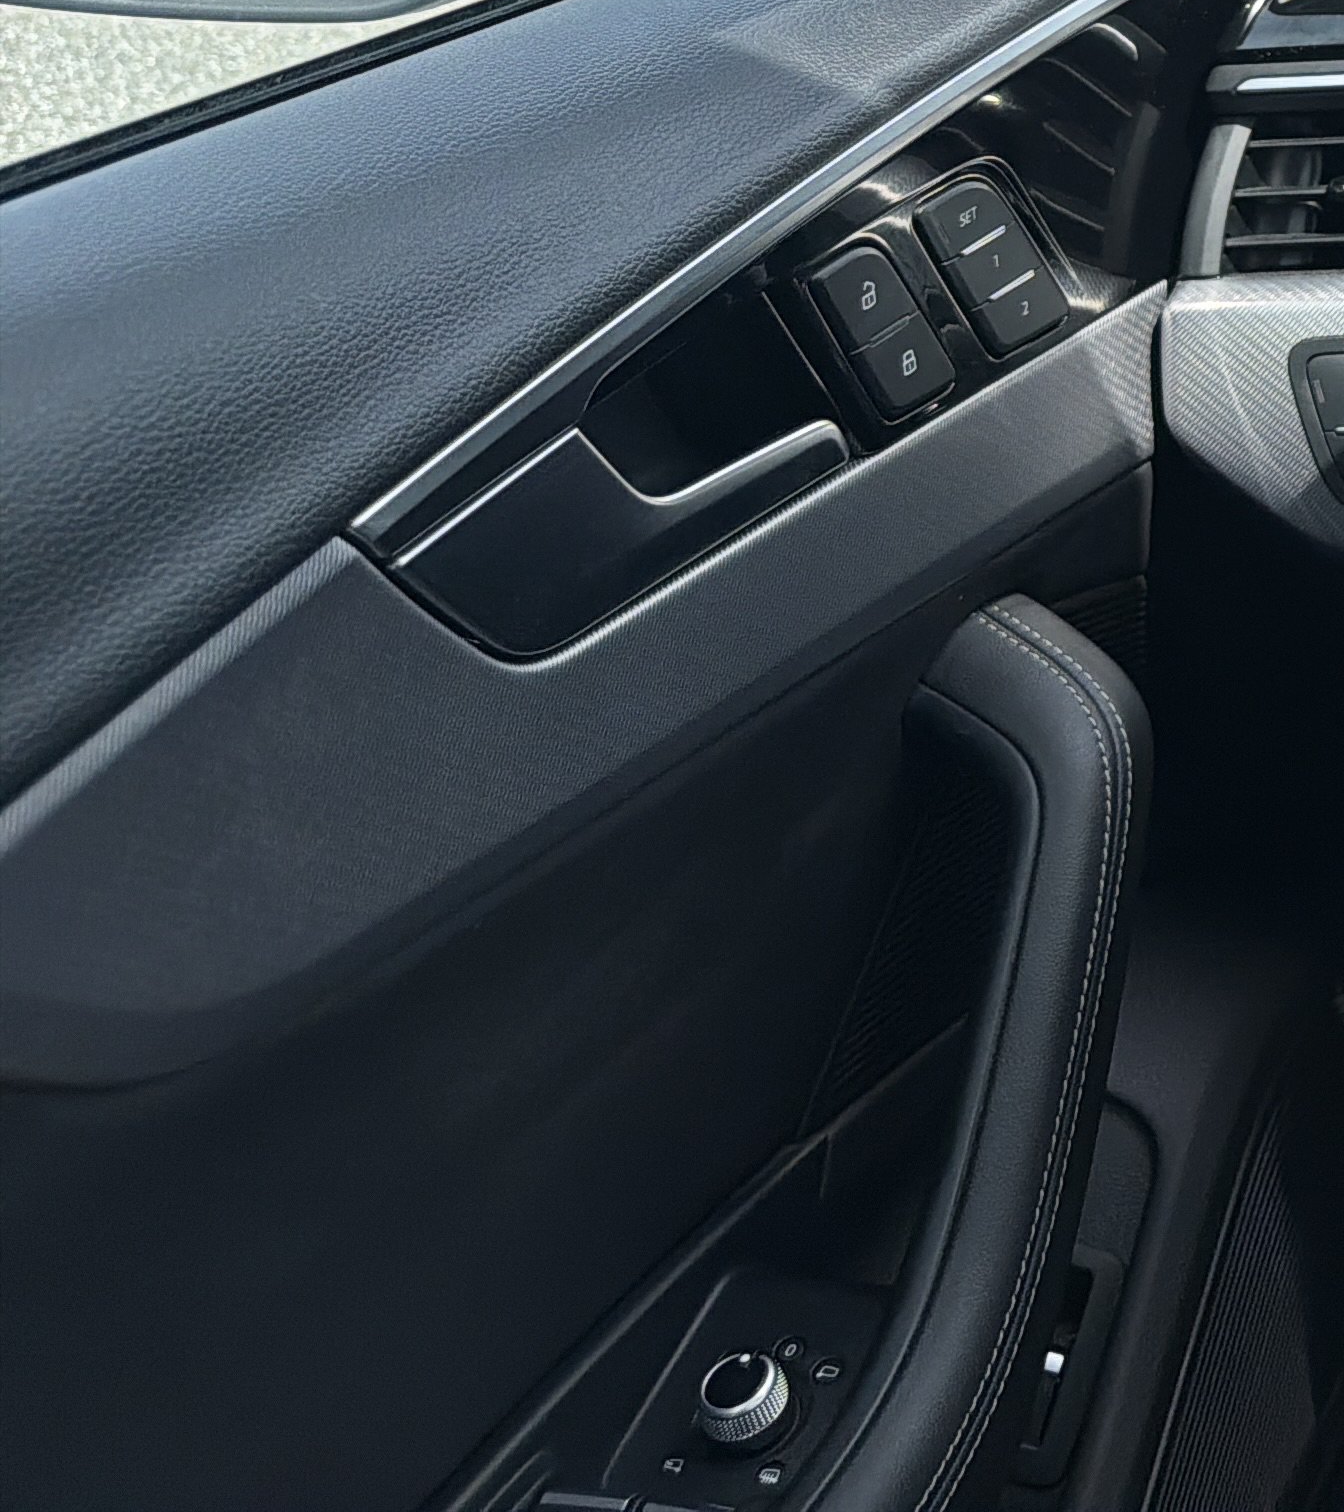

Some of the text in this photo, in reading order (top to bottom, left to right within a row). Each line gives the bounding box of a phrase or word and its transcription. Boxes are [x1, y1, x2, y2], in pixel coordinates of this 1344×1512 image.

[959, 206, 978, 227] SET
[993, 254, 1000, 268] 1
[1020, 301, 1030, 316] 2
